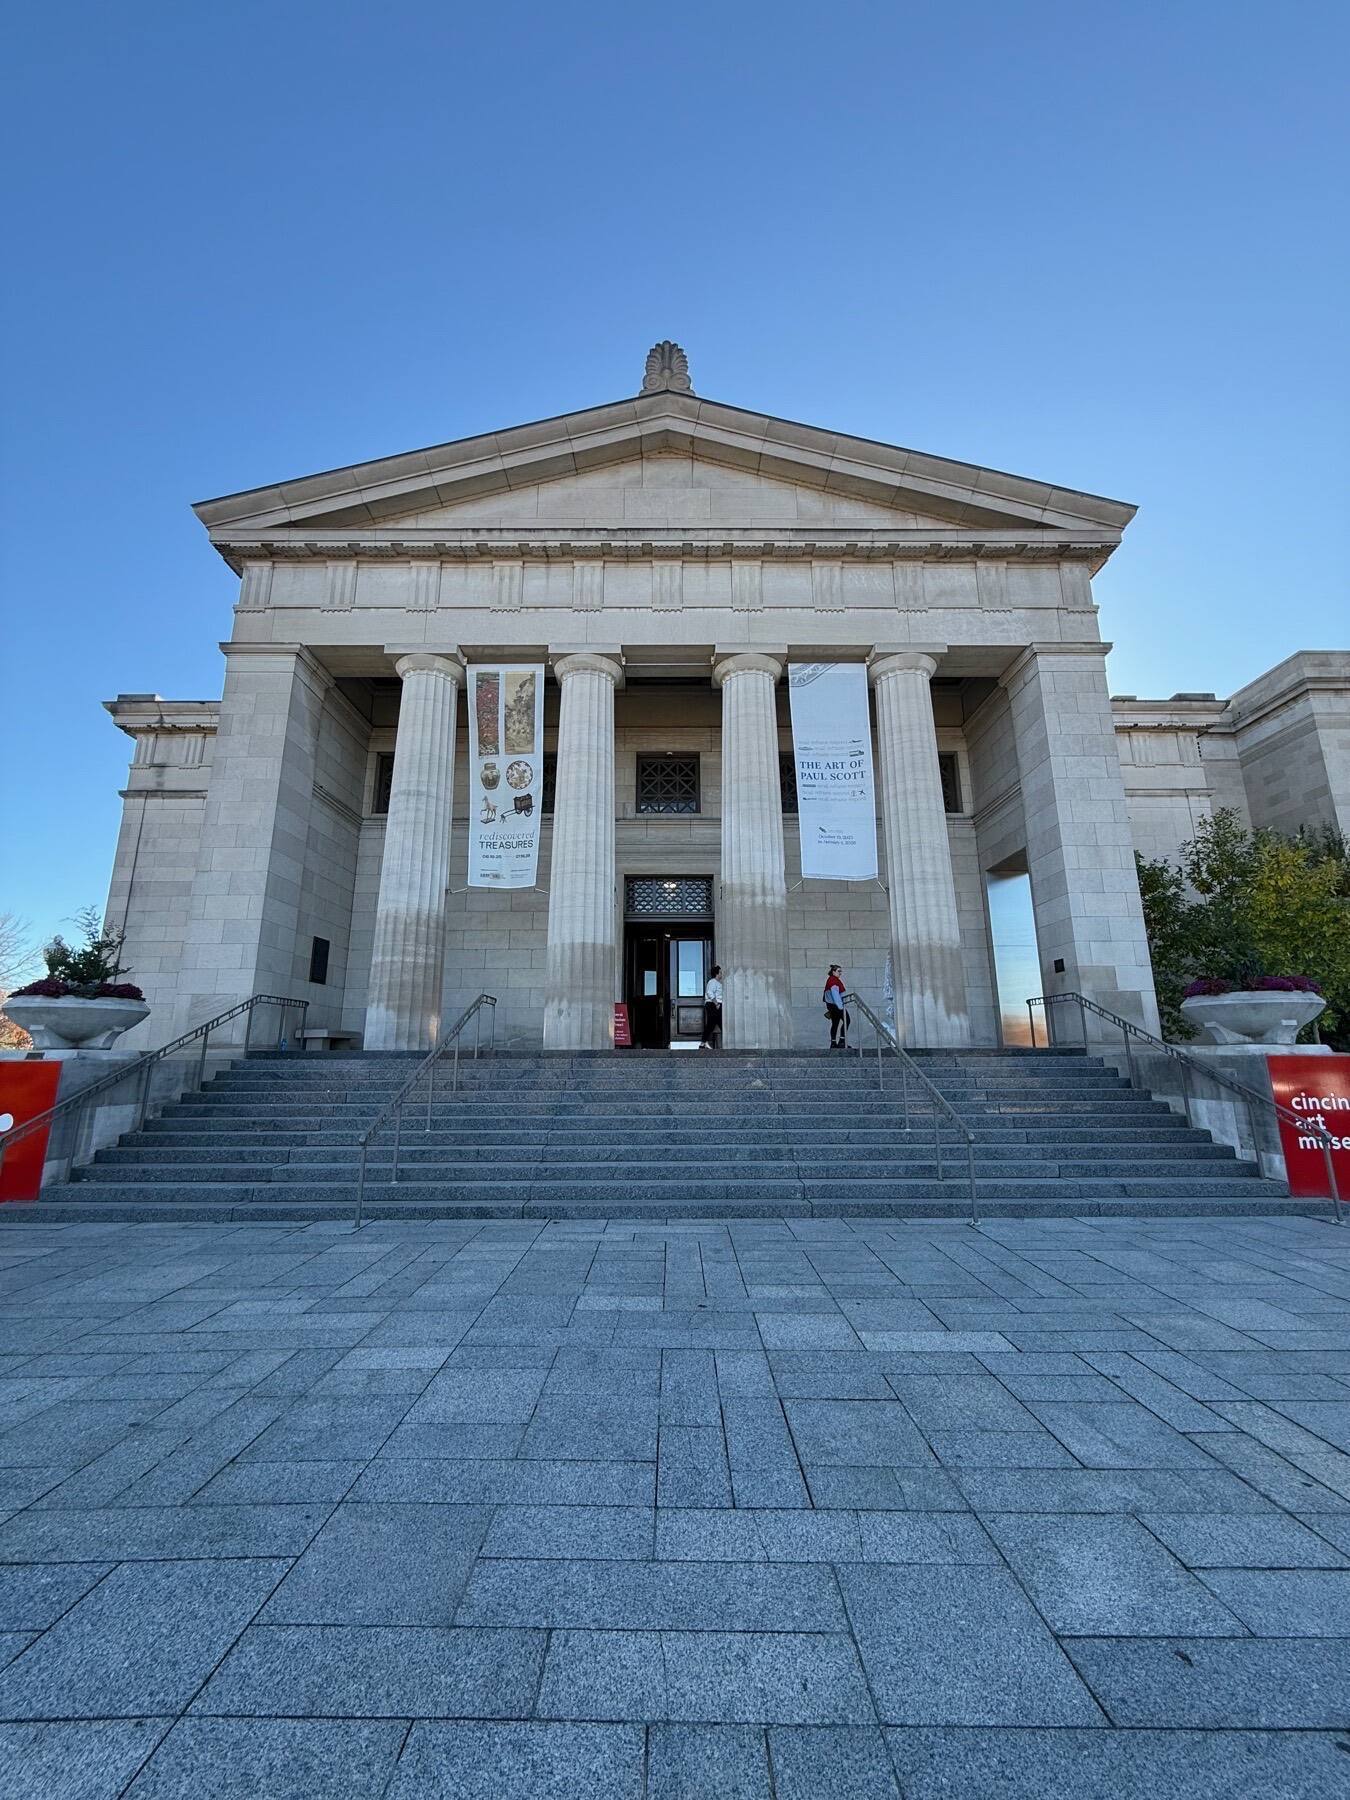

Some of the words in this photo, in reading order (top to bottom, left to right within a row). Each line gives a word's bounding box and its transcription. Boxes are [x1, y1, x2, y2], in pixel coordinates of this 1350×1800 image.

[800, 761, 821, 769] THE
[825, 761, 846, 769] ART
[850, 760, 864, 769] OF
[801, 772, 826, 780] PAUL
[830, 770, 866, 780] SCOTT
[480, 830, 535, 840] rediscovered
[479, 839, 534, 849] TREASURES
[1291, 1092, 1350, 1110] cincin
